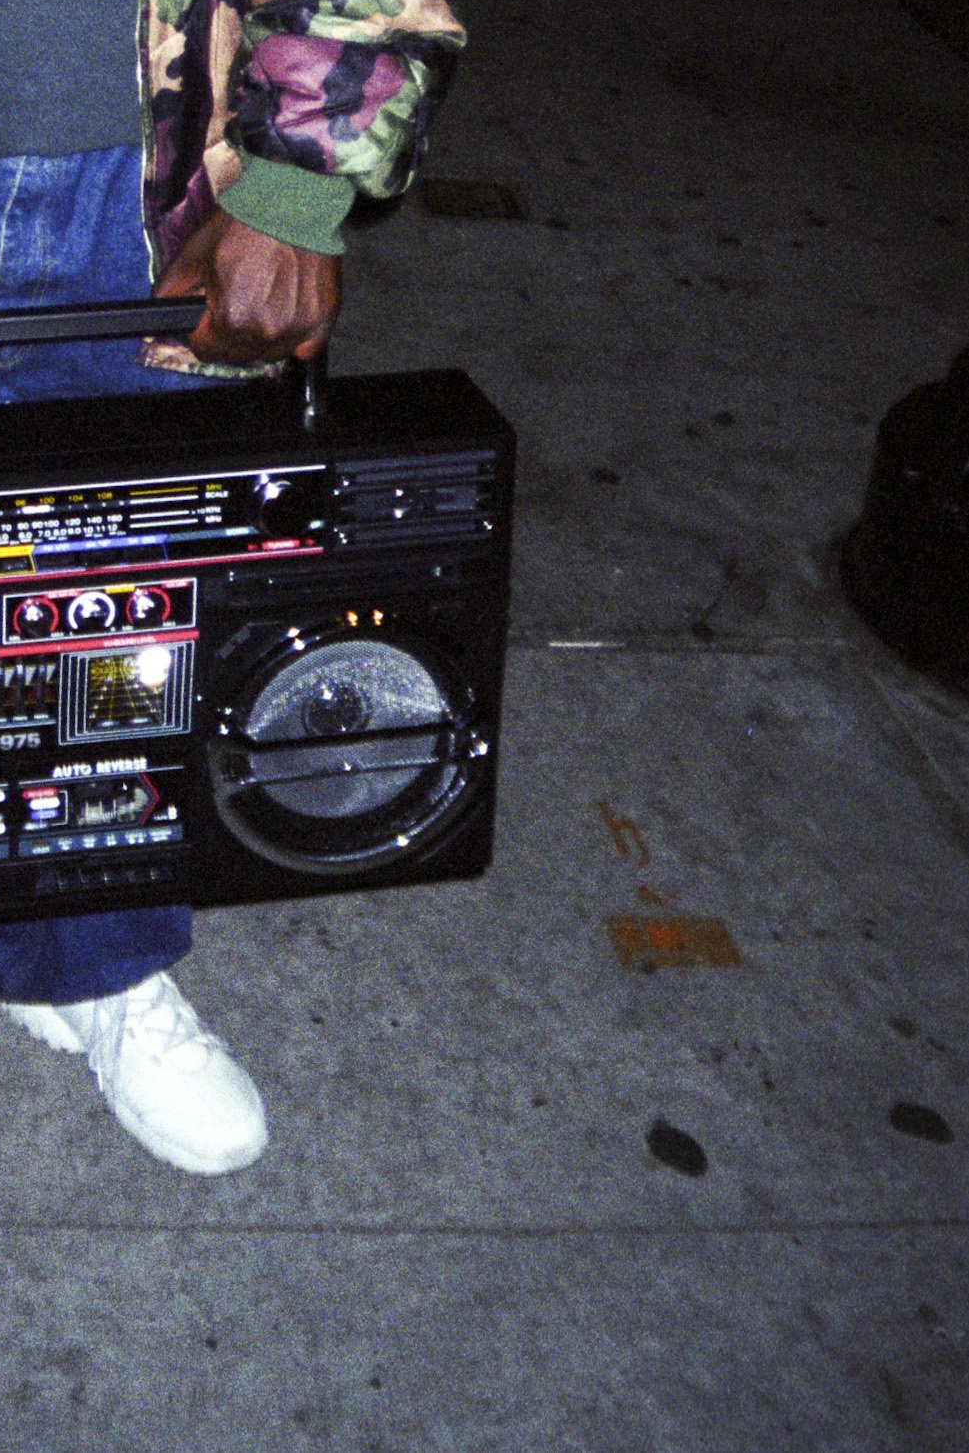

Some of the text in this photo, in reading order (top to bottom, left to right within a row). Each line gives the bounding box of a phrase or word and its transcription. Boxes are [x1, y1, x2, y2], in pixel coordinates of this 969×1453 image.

[68, 494, 83, 502] 104
[97, 492, 113, 500] 108
[1, 523, 13, 532] 70
[32, 521, 43, 529] 90
[43, 519, 59, 528] 100
[65, 517, 81, 526] 120
[86, 516, 102, 524] 140
[107, 514, 123, 523] 160
[38, 529, 52, 537] 7.0
[83, 525, 93, 533] 10
[96, 524, 106, 532] 11
[107, 523, 118, 532] 12
[53, 757, 148, 778] AUTO REVERSE
